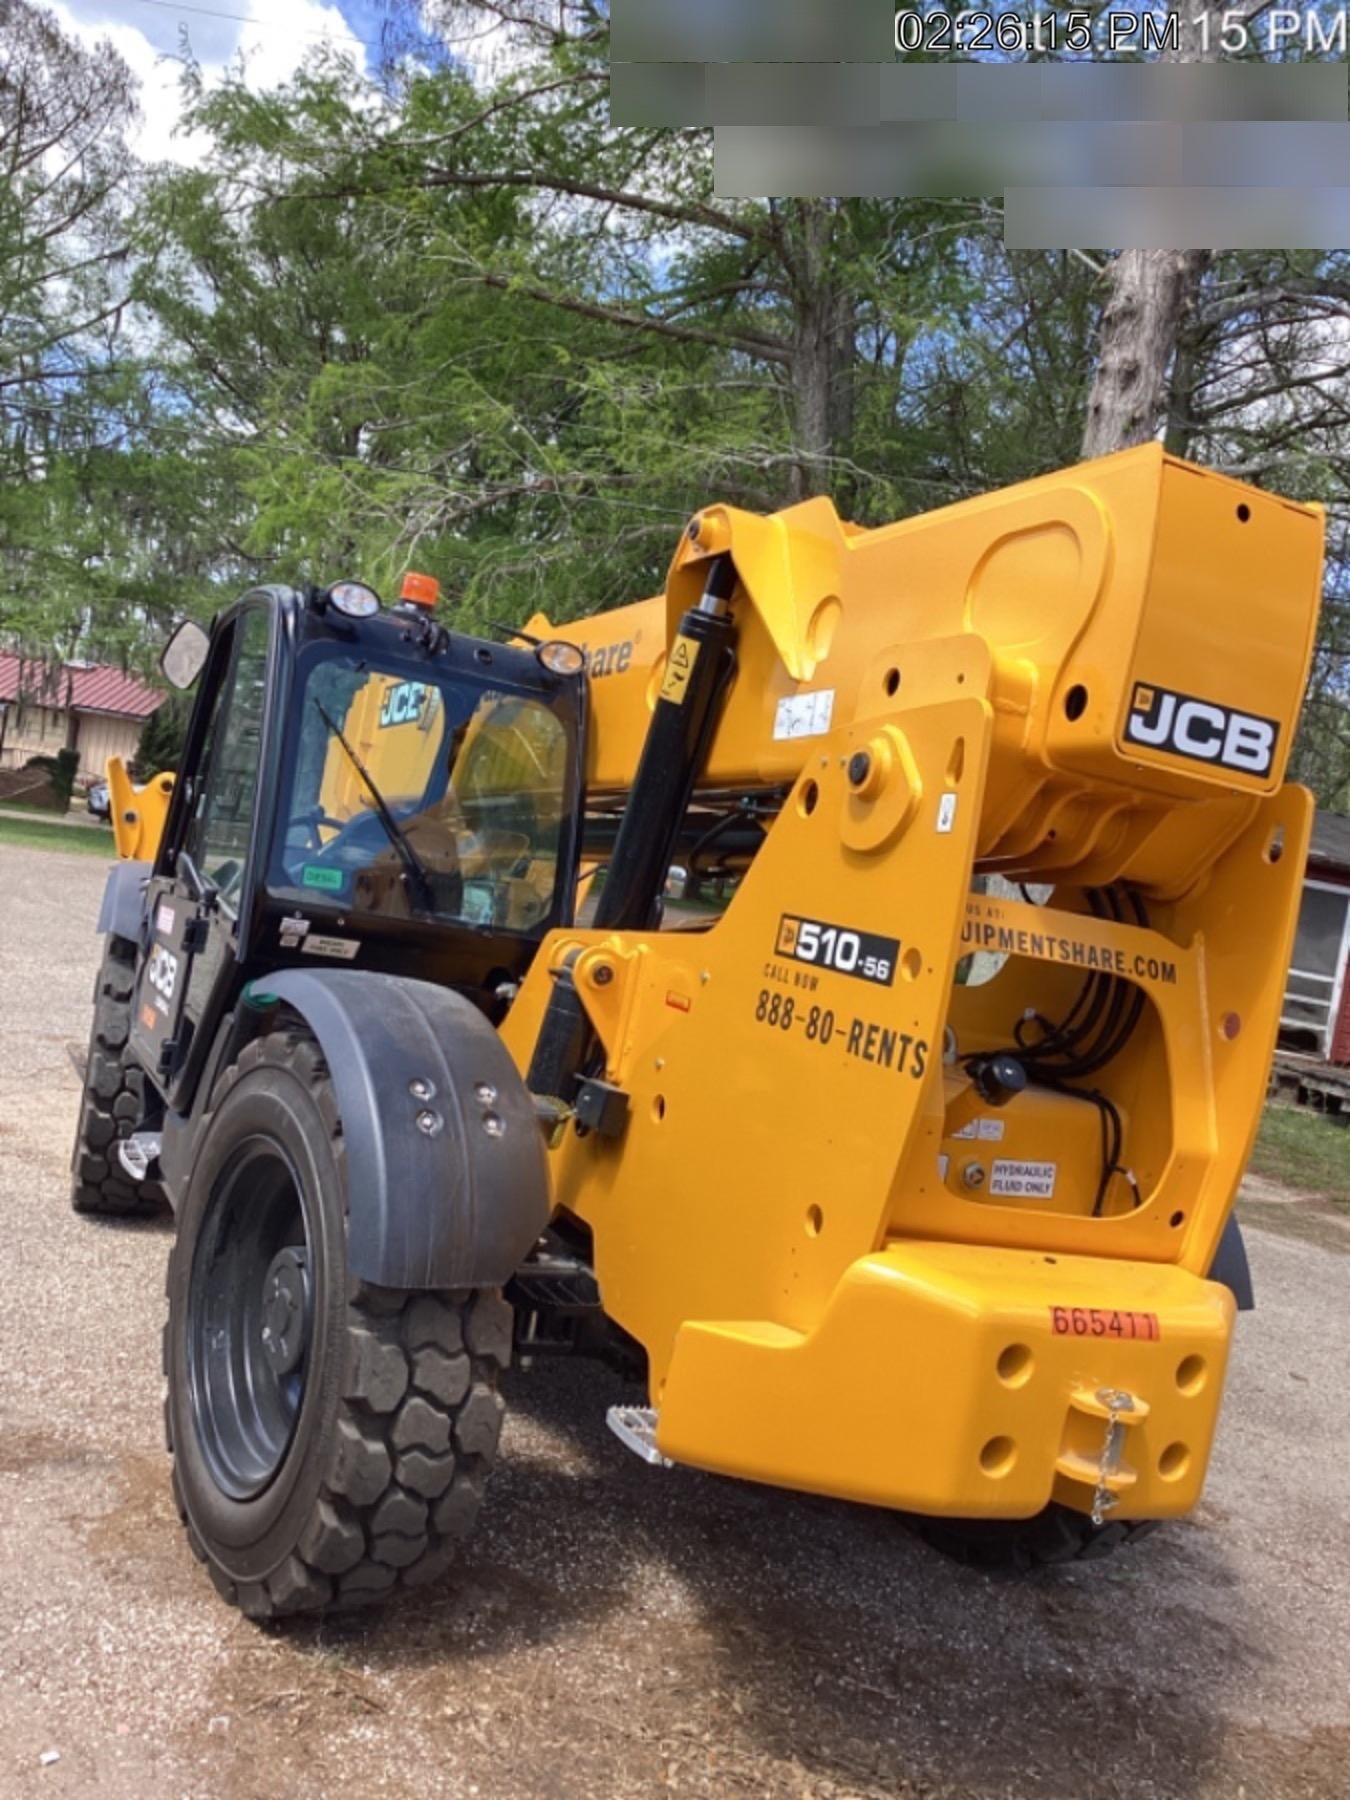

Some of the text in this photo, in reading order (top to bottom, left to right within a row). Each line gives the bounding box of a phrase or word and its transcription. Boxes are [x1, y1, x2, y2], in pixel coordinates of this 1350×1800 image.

[1129, 693, 1275, 772] JCB
[764, 962, 819, 992] CALL NOW
[755, 988, 929, 1080] 888-80-RENTS
[991, 1179, 1051, 1193] FLUID ONLY
[994, 1164, 1054, 1179] HYDRAULIC
[1052, 1306, 1154, 1341] 665411
